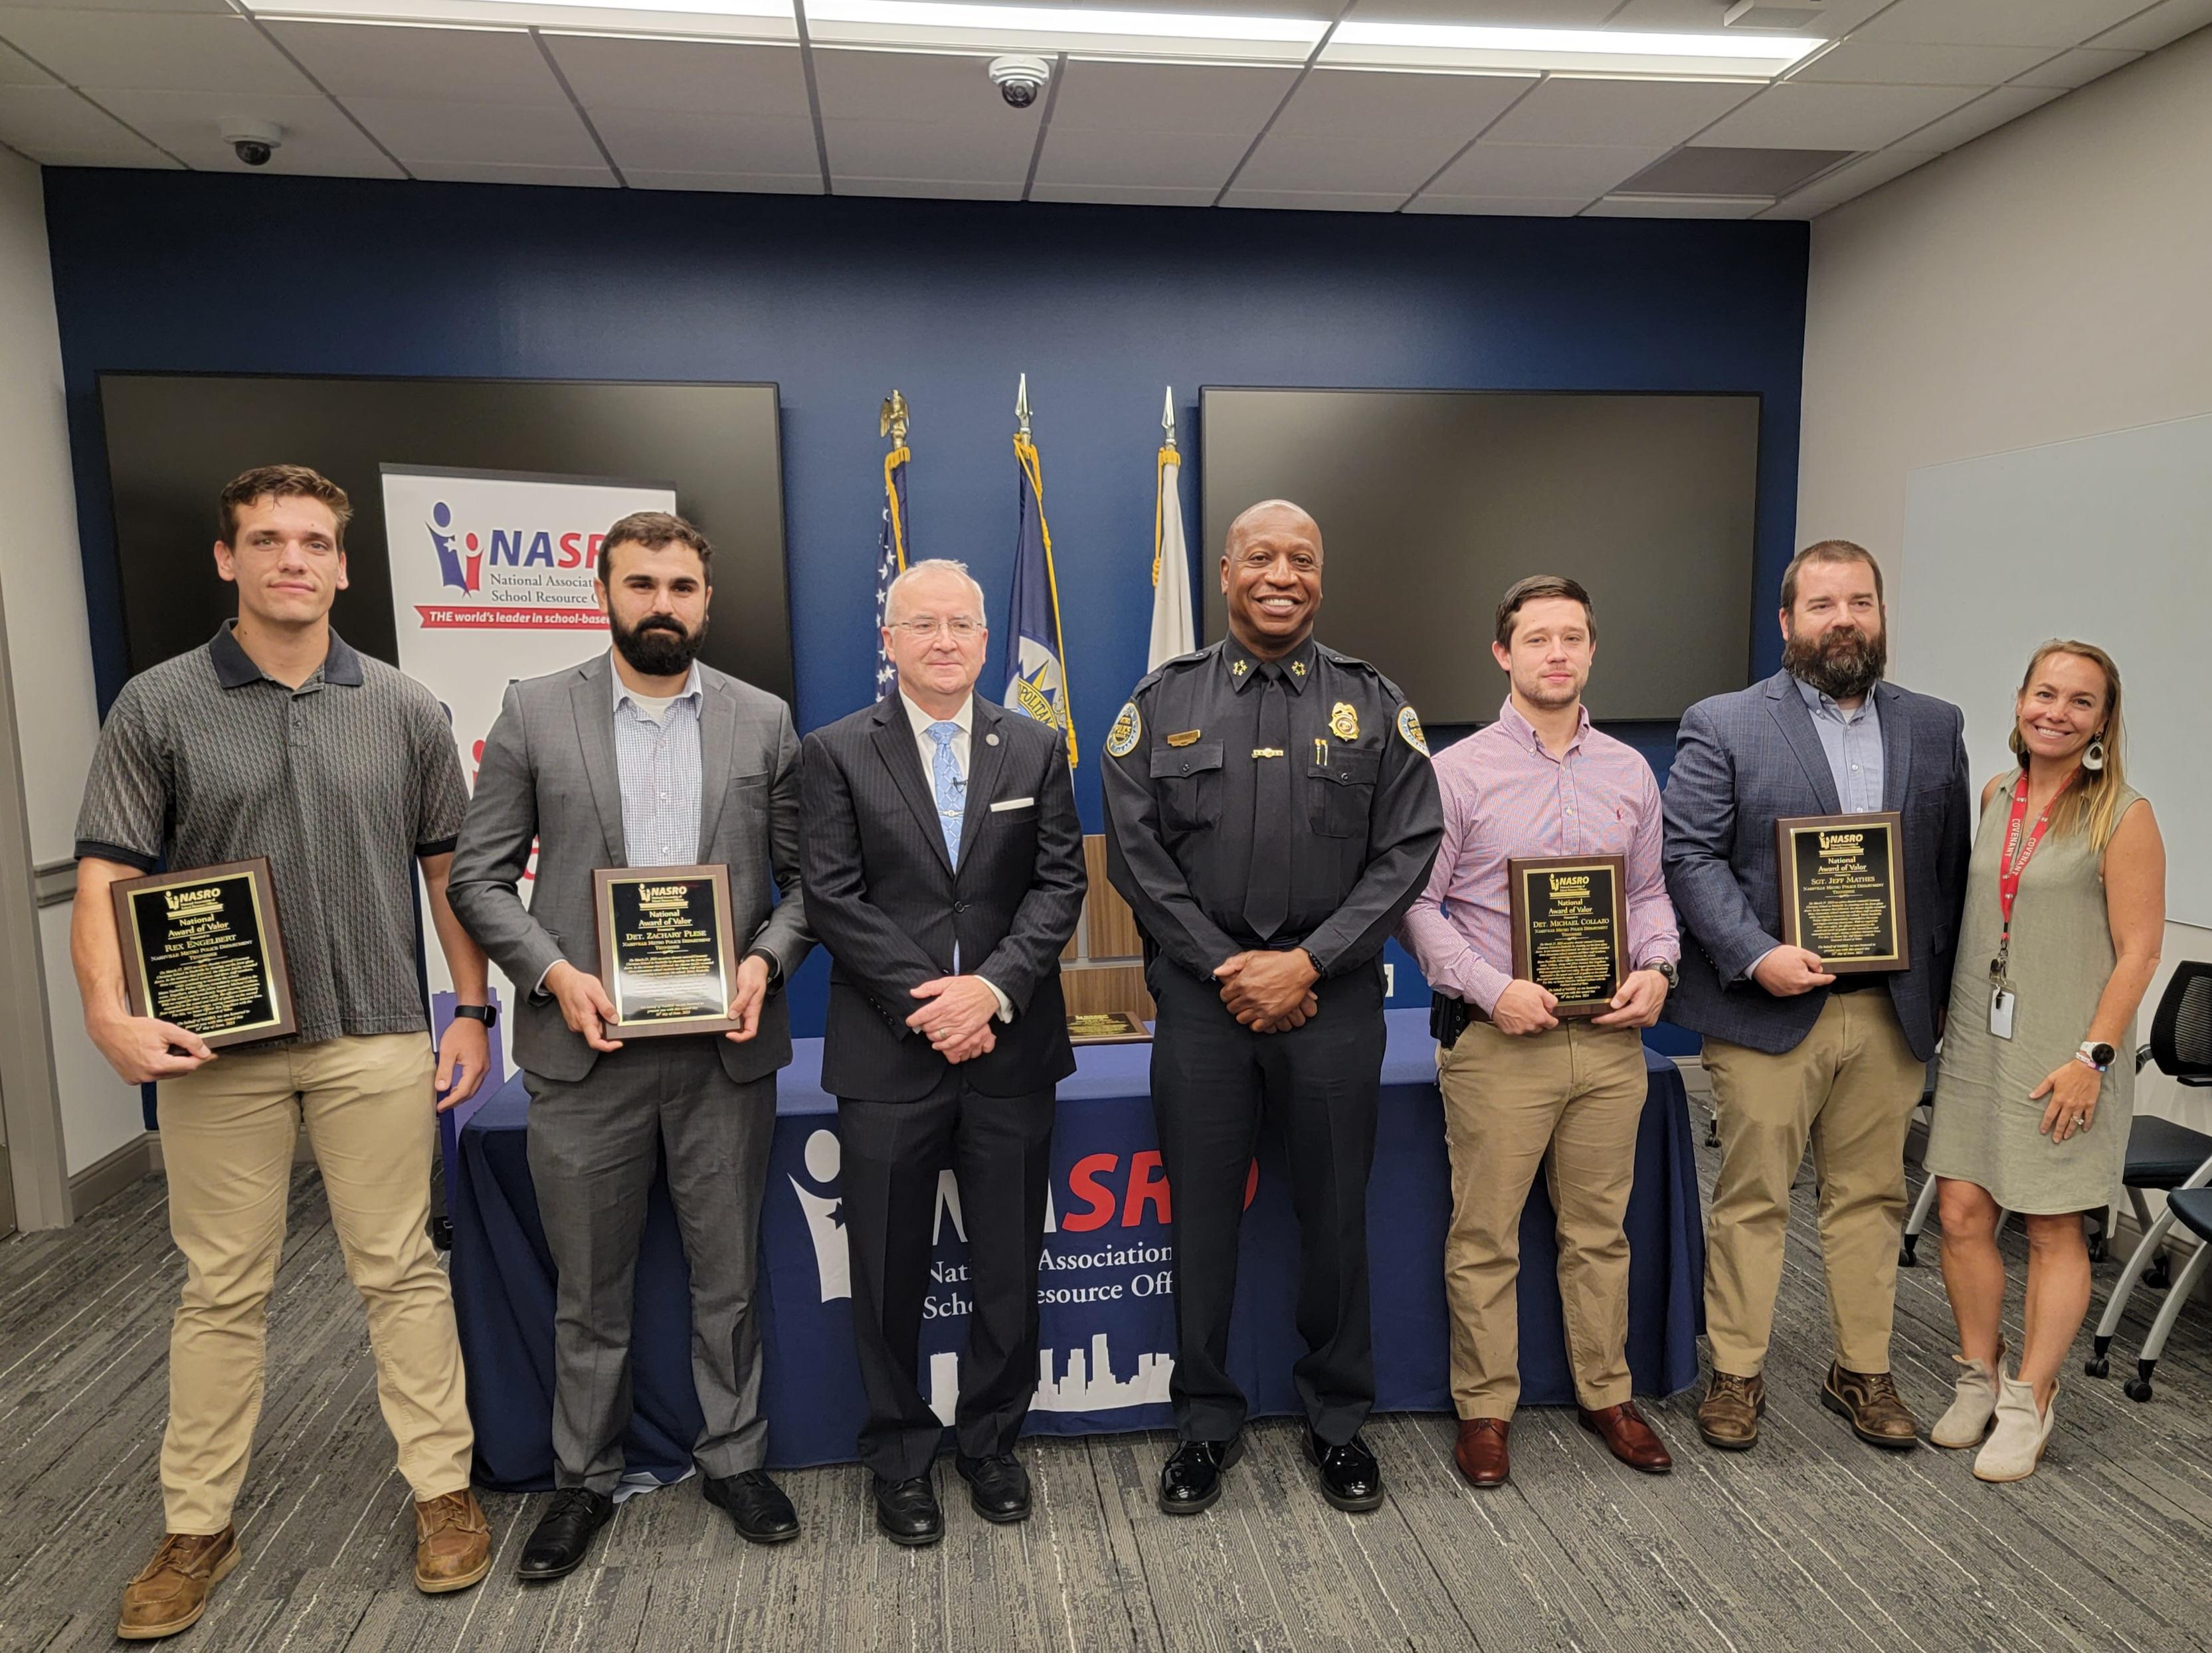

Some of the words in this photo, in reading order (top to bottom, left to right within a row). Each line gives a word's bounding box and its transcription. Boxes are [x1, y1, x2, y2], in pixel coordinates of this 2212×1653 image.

[490, 574, 541, 586] National
[492, 590, 531, 602] School
[536, 591, 588, 604] Resource
[430, 611, 453, 622] THE
[455, 611, 494, 623] world's
[496, 612, 529, 623] leader
[532, 613, 542, 624] in
[1830, 833, 1863, 843] NASRO
[2005, 818, 2021, 857] COVENANT
[1828, 855, 1855, 864] National
[2012, 837, 2036, 876] COVENANT
[1559, 876, 1589, 885] NASRO
[179, 888, 221, 903] NASRO
[651, 886, 687, 896] NASRO
[179, 913, 215, 926] National
[638, 918, 662, 927] Award
[168, 925, 195, 937] Award
[196, 923, 205, 932] of
[206, 921, 229, 930] Valor
[646, 930, 682, 939] ZACHARY
[164, 943, 184, 952] REX
[186, 934, 236, 948] ENGELBERT
[1038, 1241, 1172, 1271] Association
